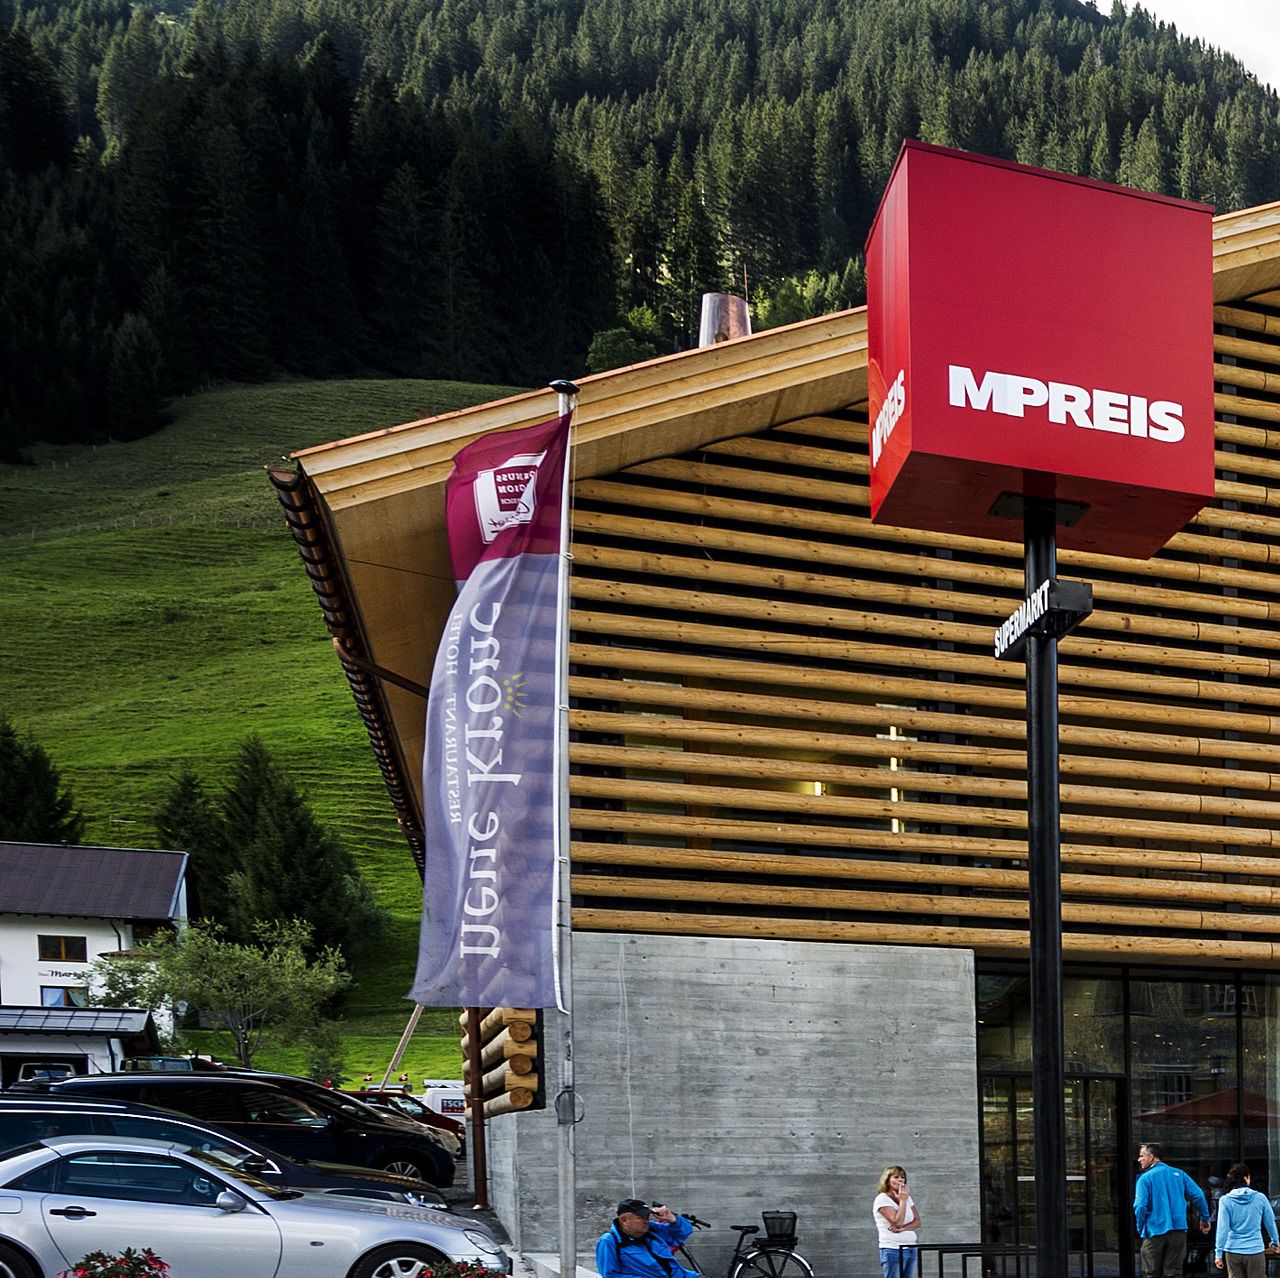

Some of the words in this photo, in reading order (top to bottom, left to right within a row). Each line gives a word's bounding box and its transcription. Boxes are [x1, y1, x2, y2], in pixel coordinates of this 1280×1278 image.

[872, 369, 906, 468] MPREIS
[949, 364, 1186, 443] MPREIS
[994, 579, 1050, 658] SUPERMARKT
